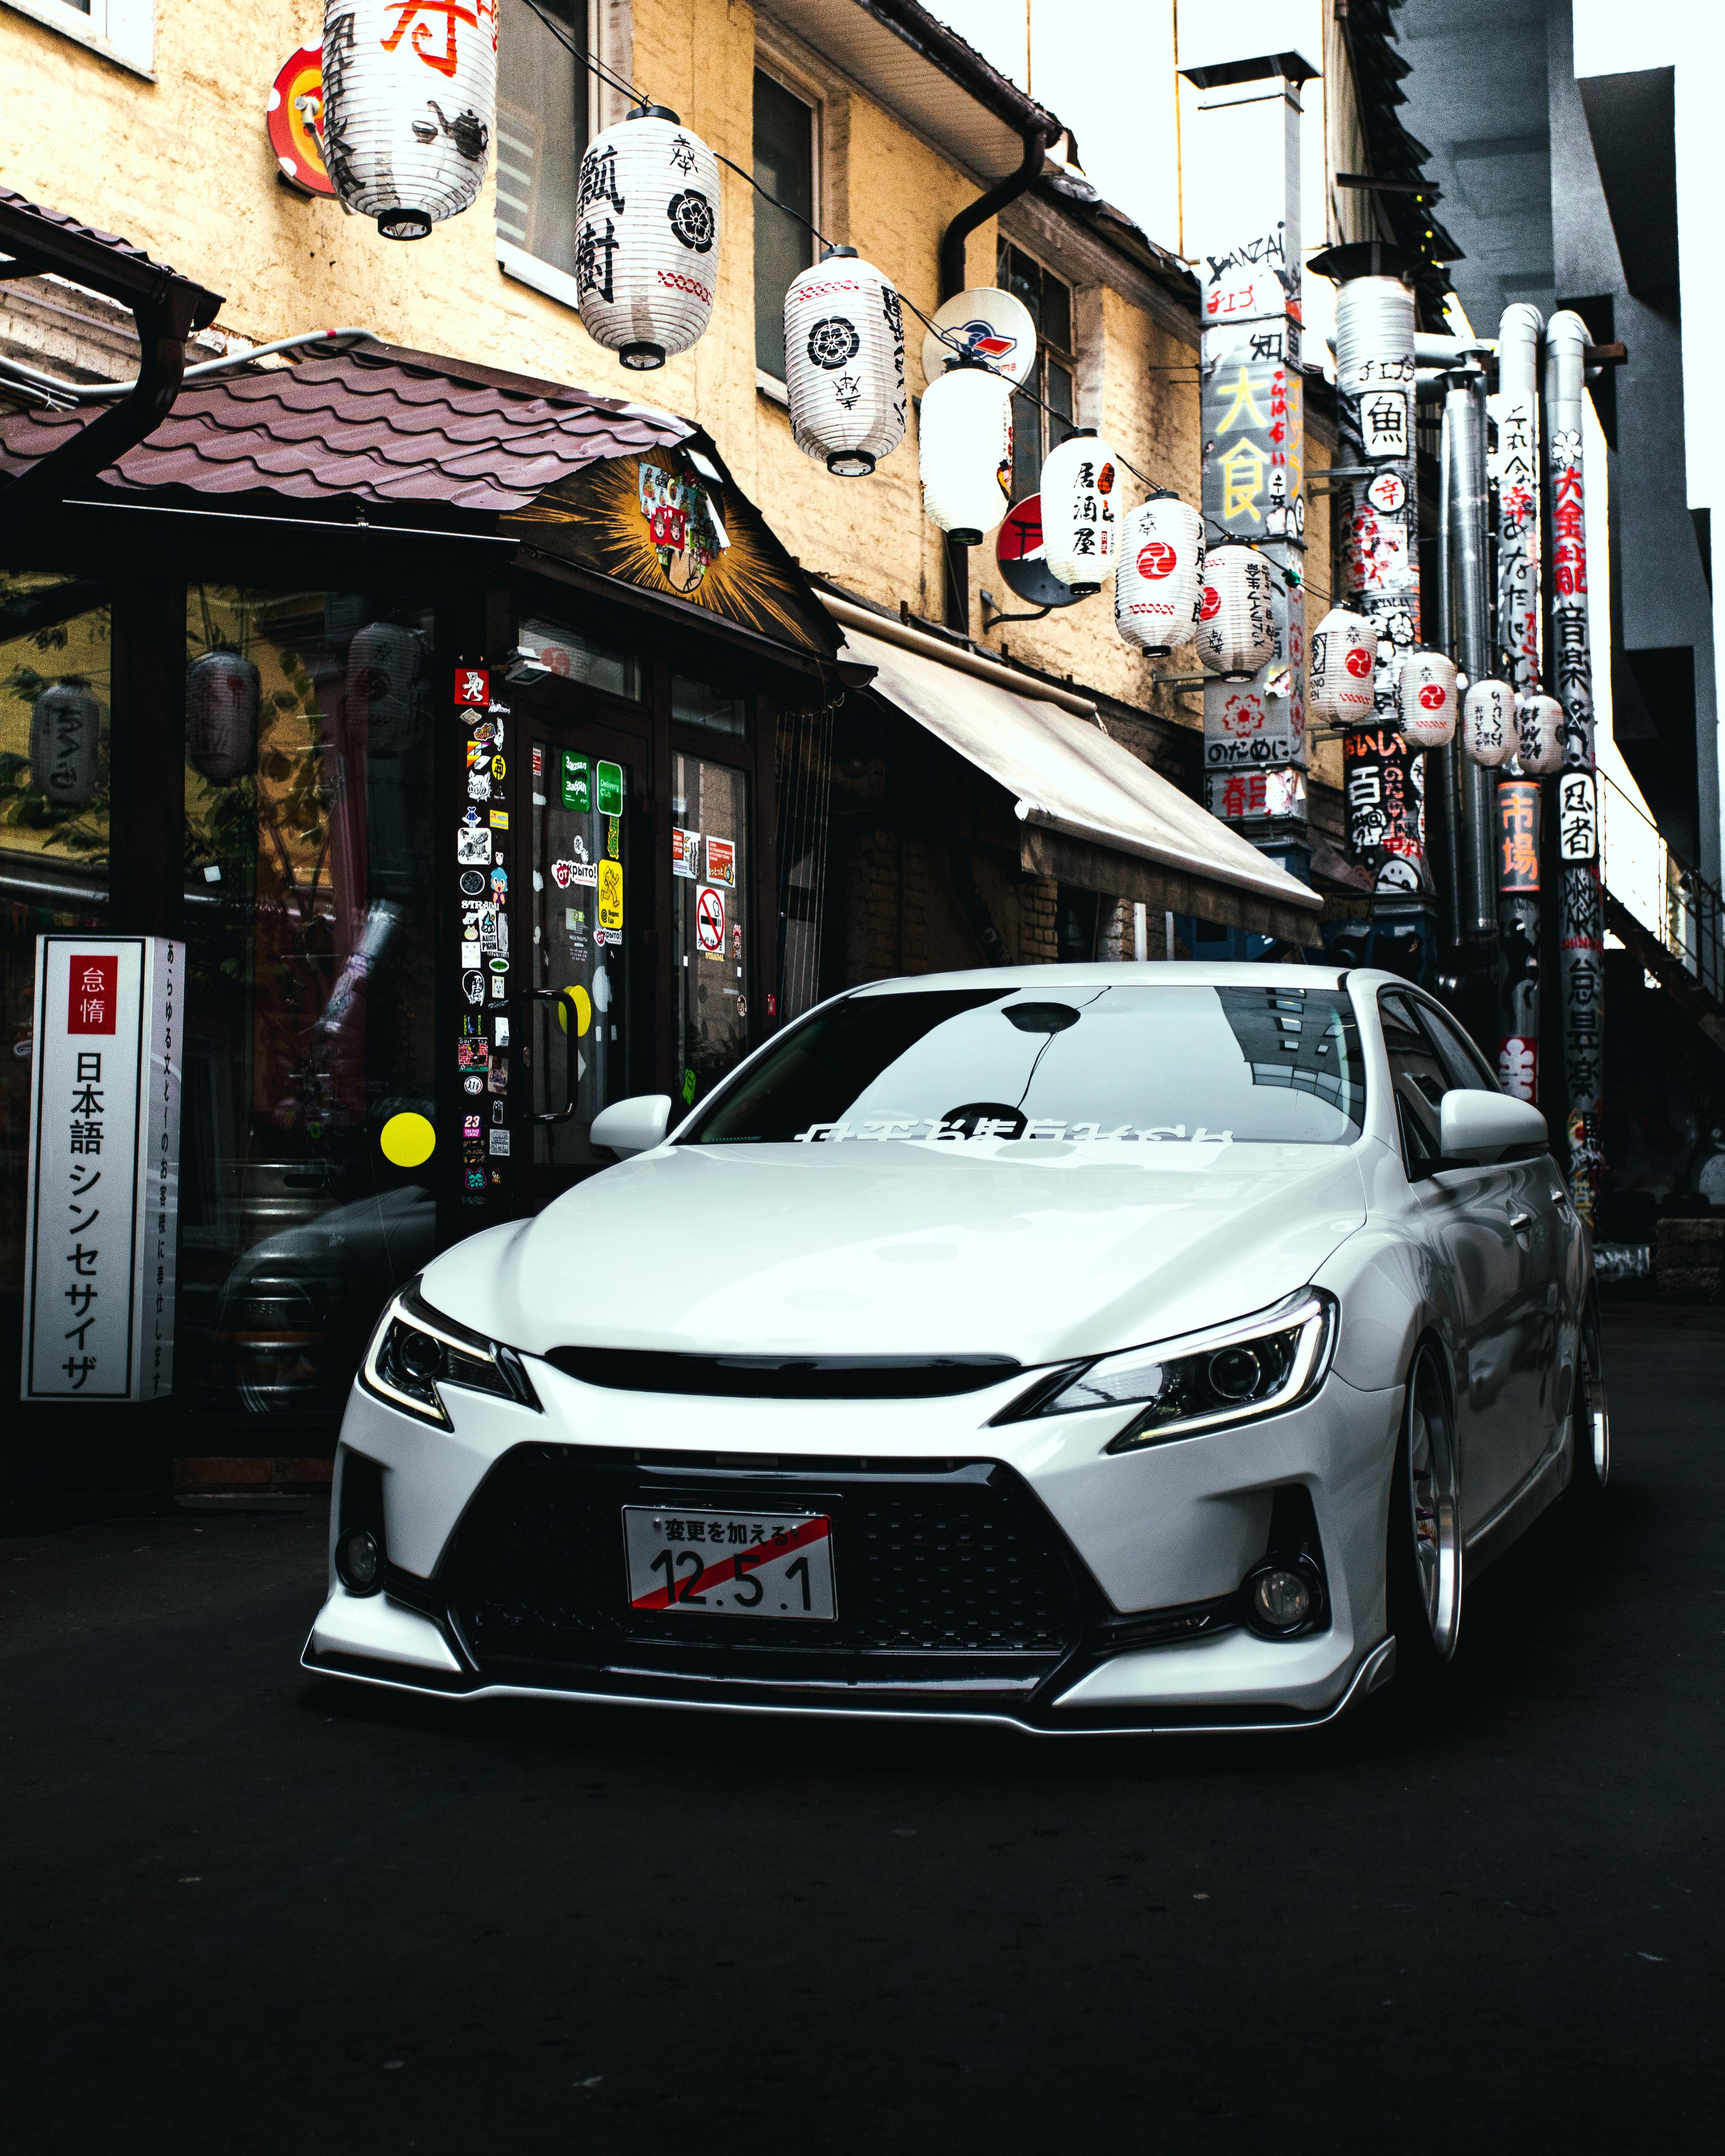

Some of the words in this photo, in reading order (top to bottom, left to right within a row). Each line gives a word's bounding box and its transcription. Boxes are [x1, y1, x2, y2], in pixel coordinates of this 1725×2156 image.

[1216, 367, 1270, 522] 大食
[1367, 395, 1403, 445] 魚
[1072, 462, 1098, 556] 居酒屋
[1208, 738, 1290, 762] のために
[600, 779, 619, 792] Delivery
[1501, 792, 1538, 881] 市場
[1562, 780, 1594, 856] 忍者
[608, 909, 620, 918] Яндекс
[464, 1116, 480, 1128] 23
[61, 1052, 106, 1391] 日本語シンセサイザ
[664, 1518, 789, 1547] 変更を加える
[650, 1548, 812, 1612] 12.5.1
